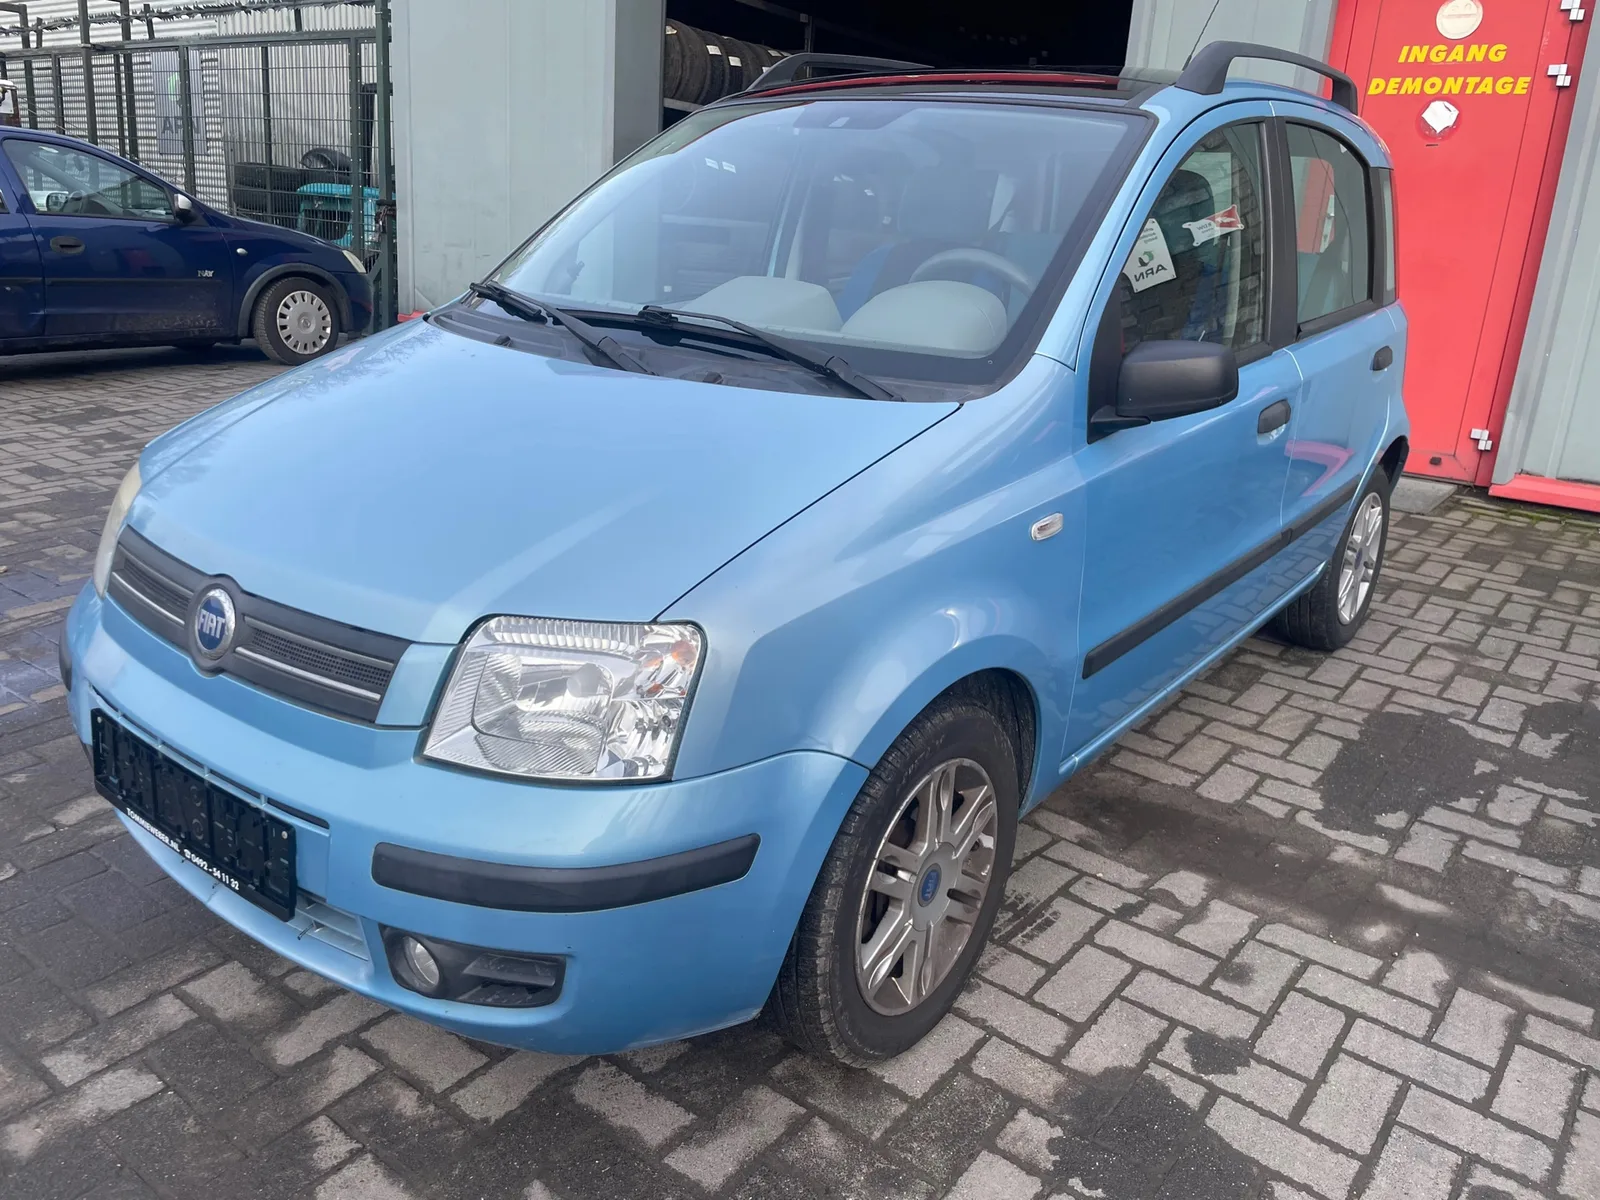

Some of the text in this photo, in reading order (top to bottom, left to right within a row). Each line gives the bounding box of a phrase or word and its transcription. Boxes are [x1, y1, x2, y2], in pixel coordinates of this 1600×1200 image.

[1398, 43, 1508, 63] INGANG
[1367, 76, 1532, 95] DEMONTAGE
[198, 608, 226, 639] FIAT
